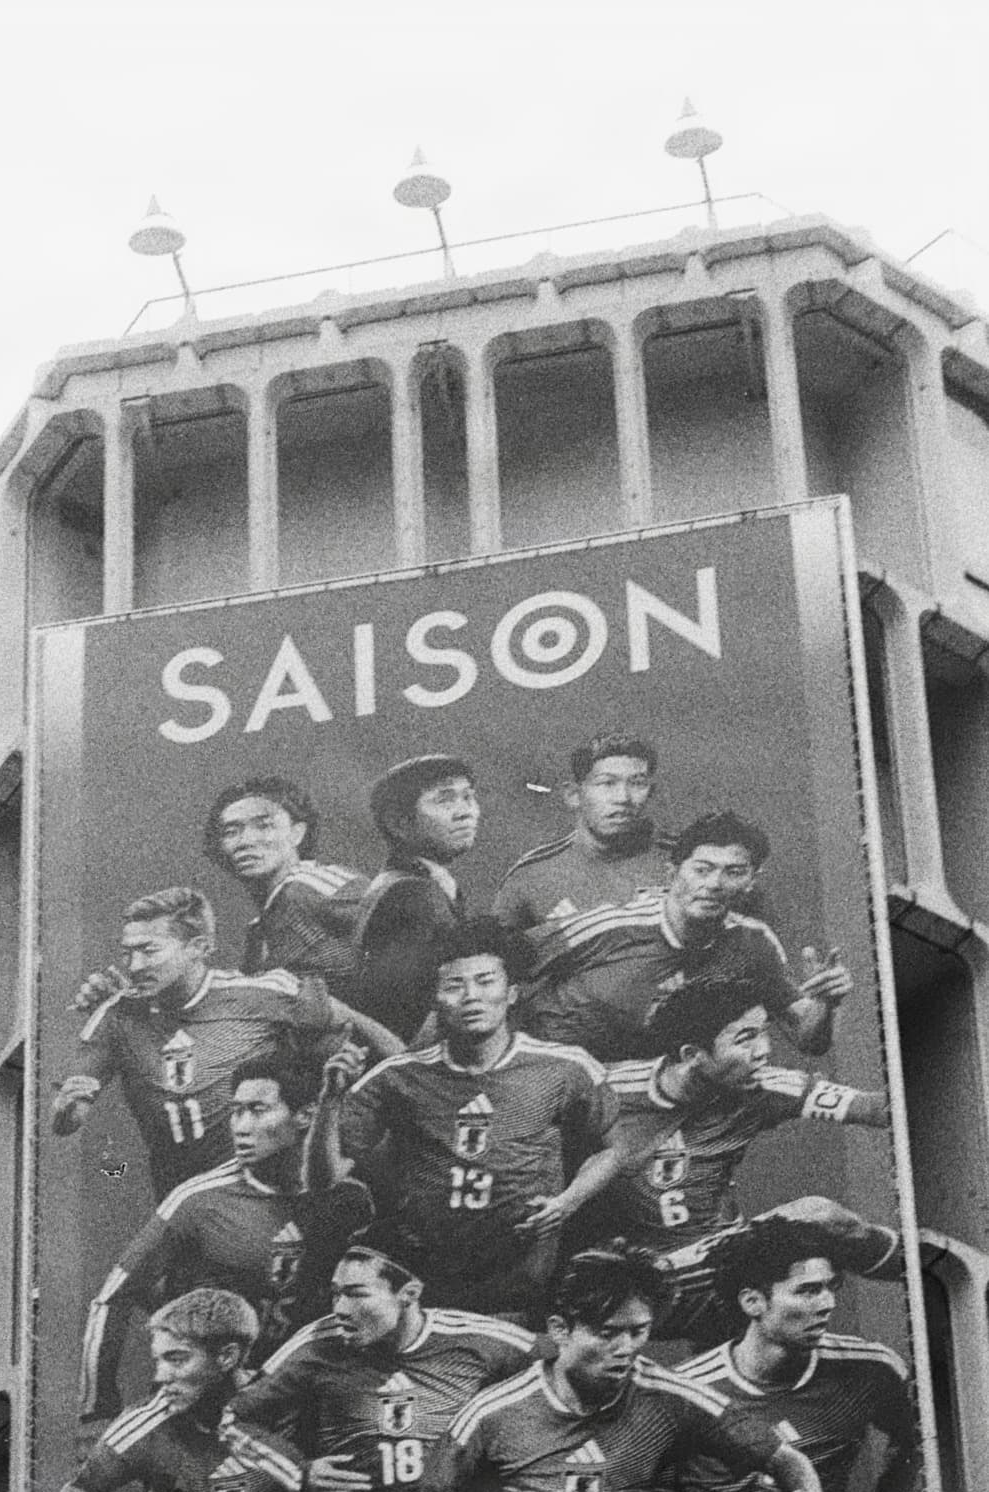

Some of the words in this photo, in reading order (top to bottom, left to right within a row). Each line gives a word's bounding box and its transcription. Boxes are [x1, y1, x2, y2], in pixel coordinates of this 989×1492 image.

[159, 567, 722, 743] SAISON
[165, 1099, 205, 1143] 11
[449, 1166, 494, 1210] 13
[659, 1189, 690, 1228] 6
[377, 1439, 425, 1486] 18
